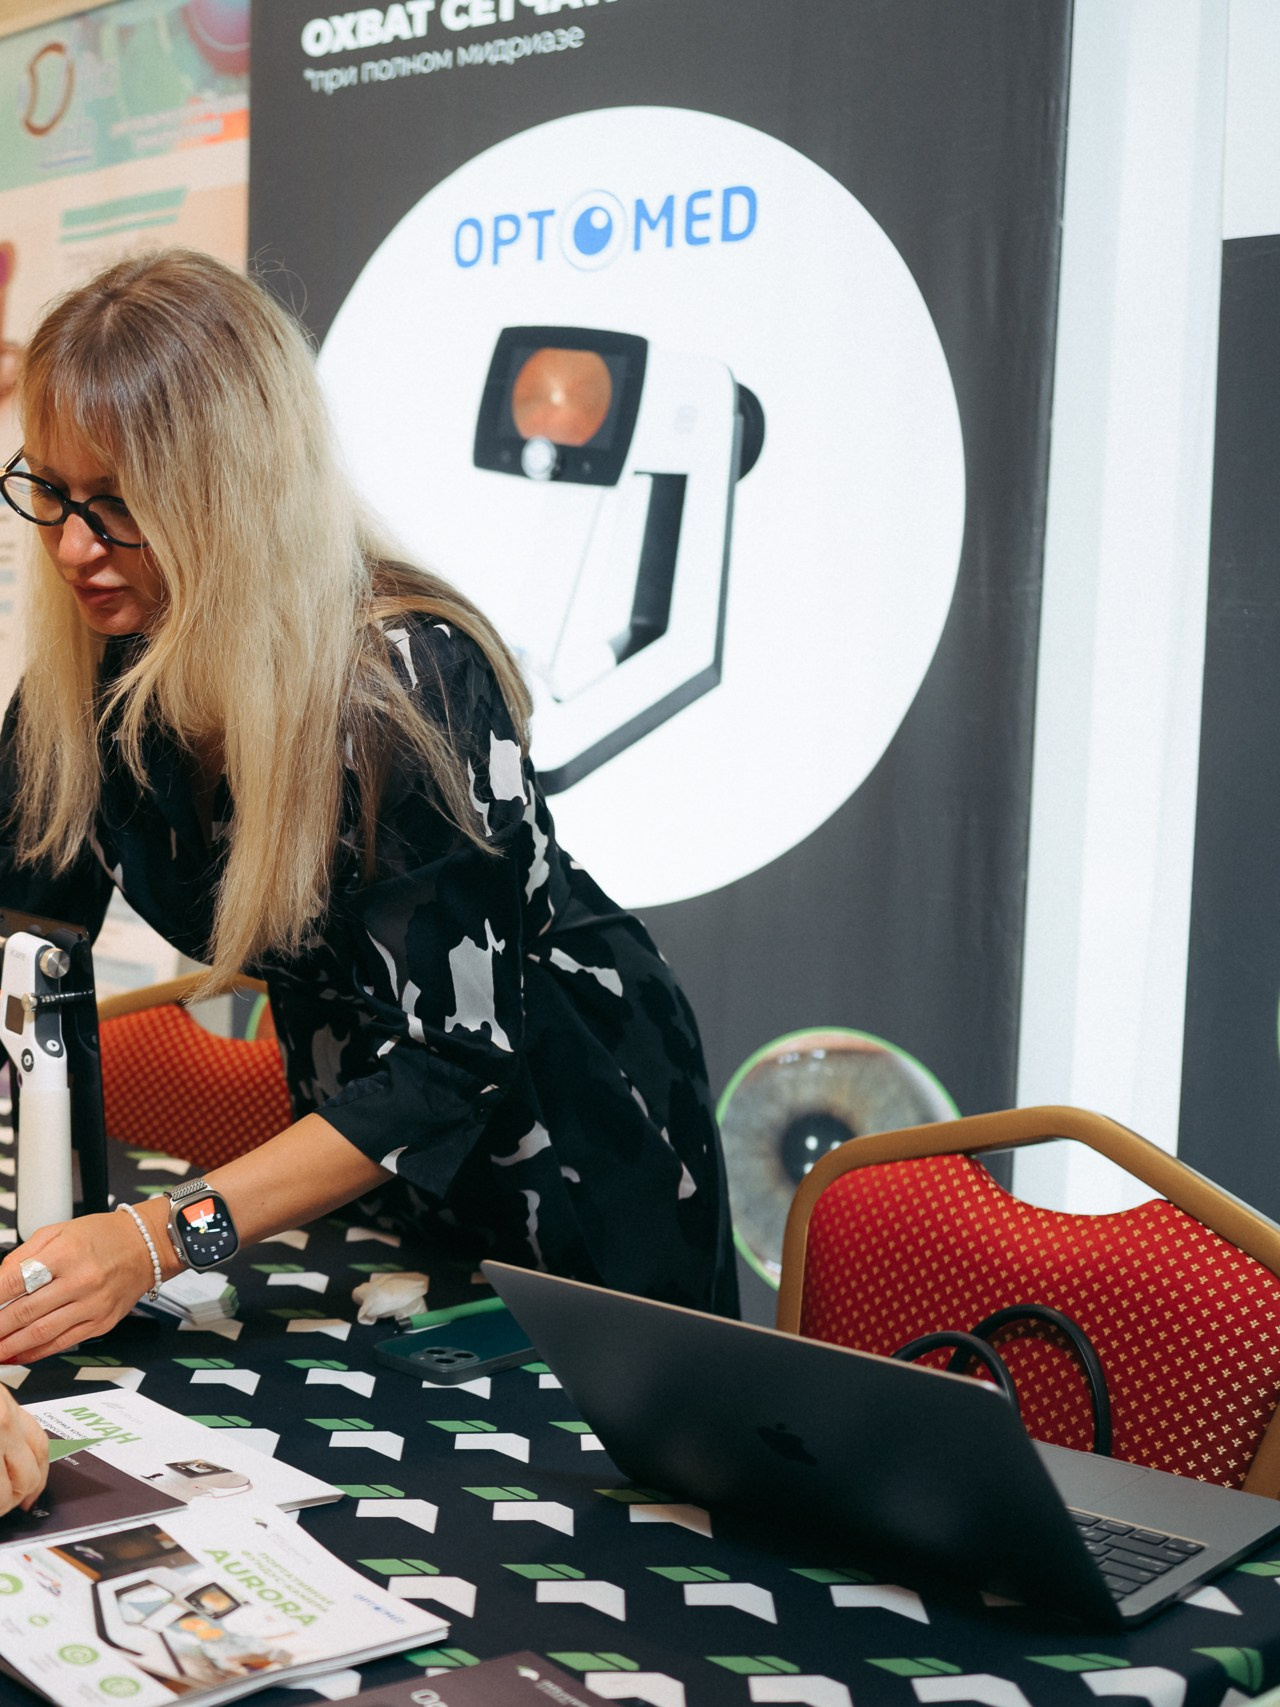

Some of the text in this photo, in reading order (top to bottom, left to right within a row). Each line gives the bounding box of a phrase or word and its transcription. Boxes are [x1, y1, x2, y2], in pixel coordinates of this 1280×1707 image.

[301, 0, 435, 57] ОХВАТ
[361, 49, 453, 83] полном
[457, 26, 586, 66] мидриазе
[454, 185, 758, 271] OPTOMED
[62, 1406, 143, 1444] MYAH
[202, 1548, 319, 1627] AURORA
